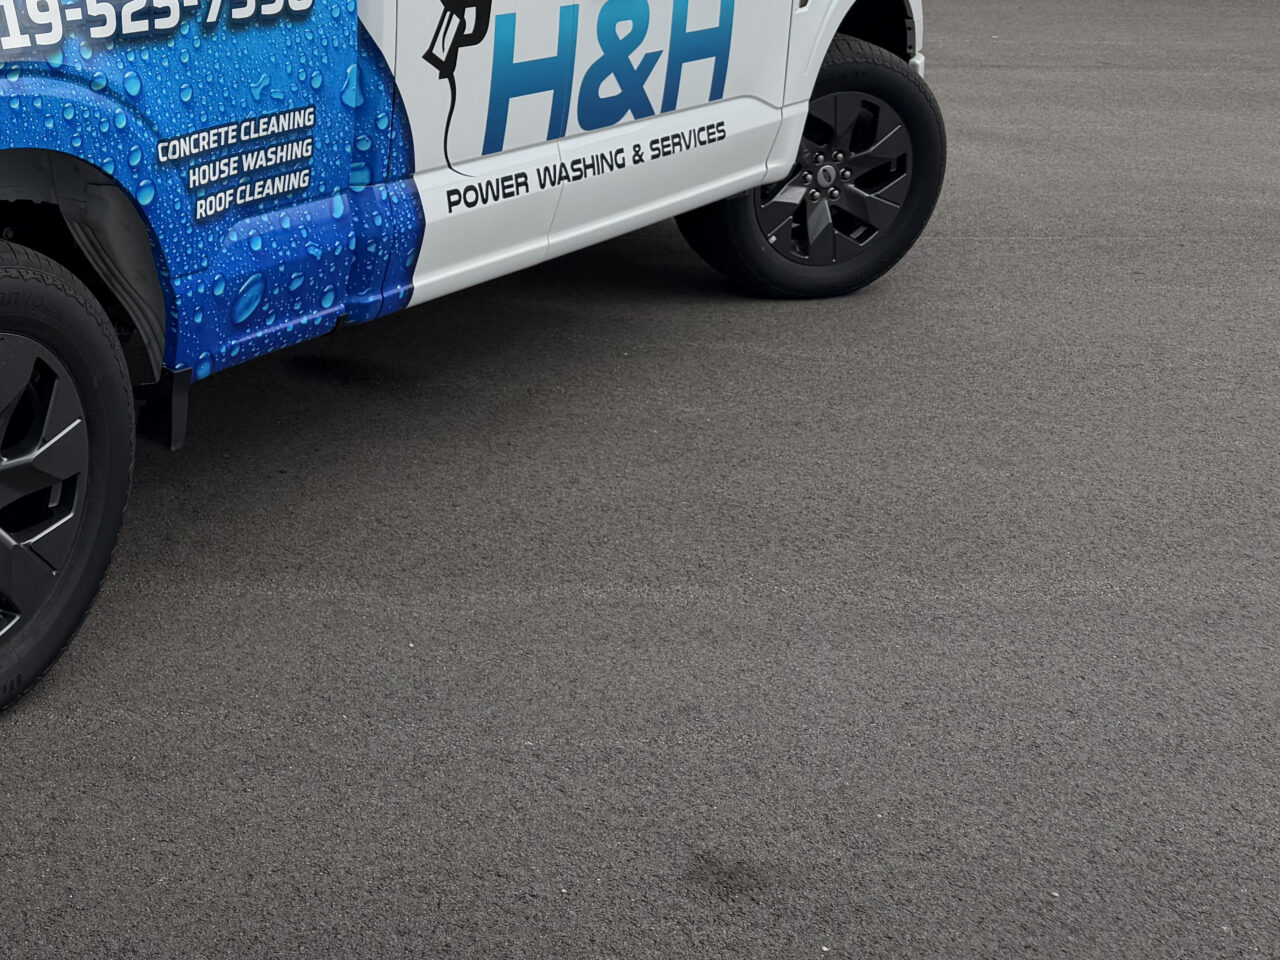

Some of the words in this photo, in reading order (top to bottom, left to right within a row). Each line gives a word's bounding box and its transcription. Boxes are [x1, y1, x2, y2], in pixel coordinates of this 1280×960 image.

[157, 127, 238, 162] CONCRETE
[240, 107, 315, 143] CLEANING
[189, 161, 239, 189] HOUSE
[242, 138, 314, 175] WASHING
[446, 172, 529, 213] POWER
[536, 148, 625, 189] WASHING
[632, 144, 645, 165] &
[649, 121, 726, 160] SERVICES
[196, 190, 235, 221] ROOF
[236, 170, 310, 206] CLEANING
